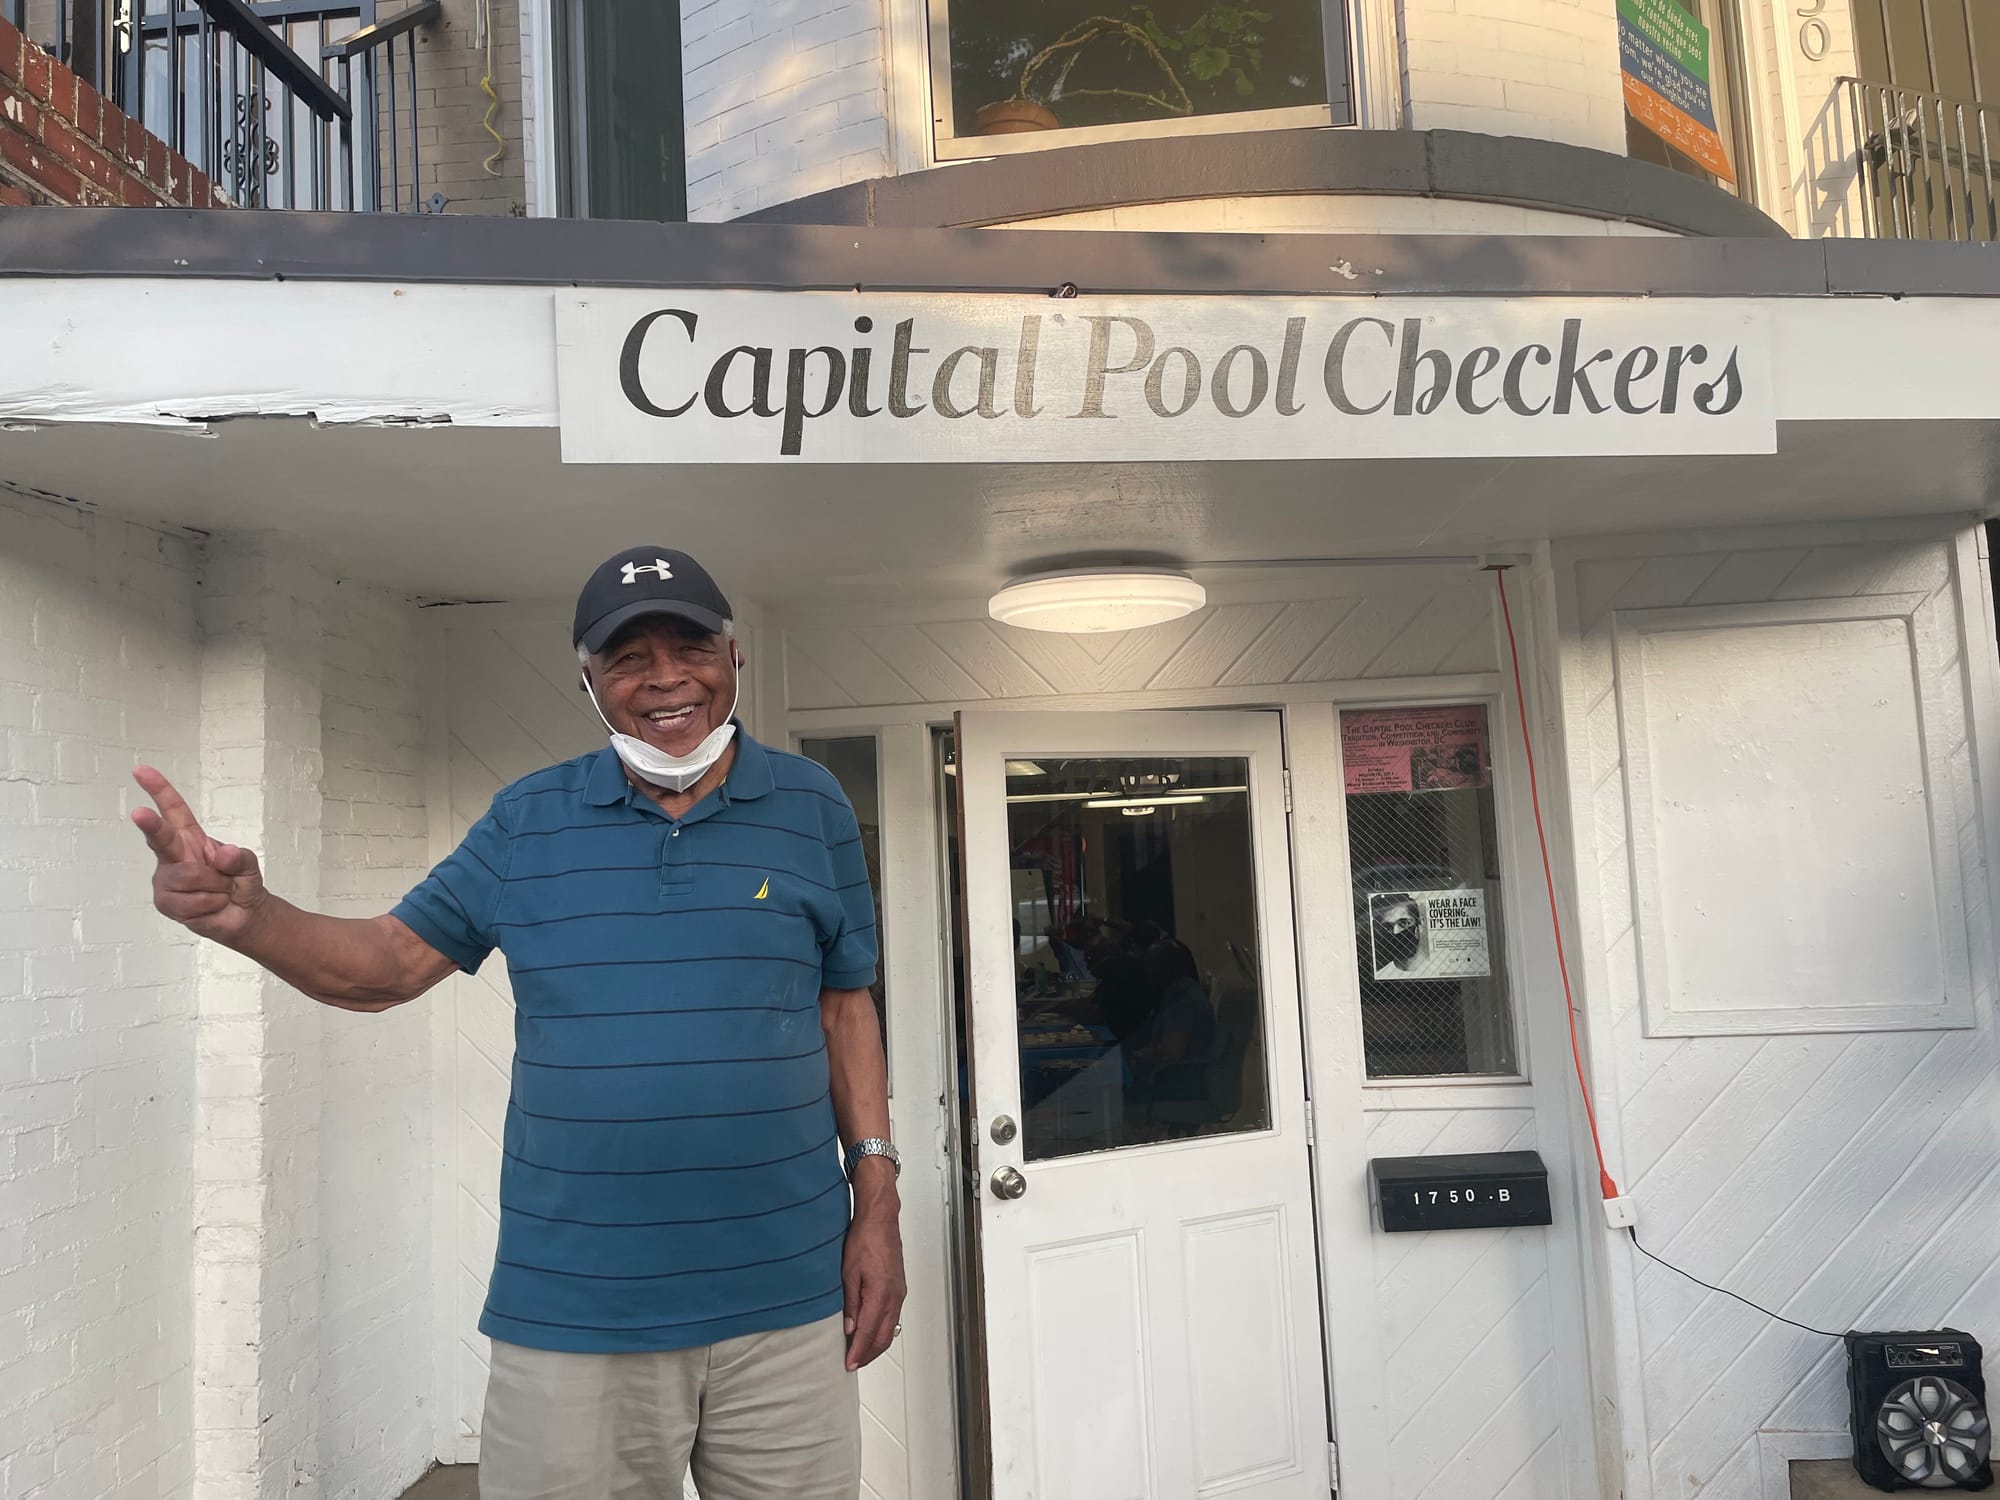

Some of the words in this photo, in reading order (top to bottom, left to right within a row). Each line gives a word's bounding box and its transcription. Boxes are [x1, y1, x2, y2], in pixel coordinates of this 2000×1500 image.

[1638, 15, 1660, 42] nuestro
[1647, 7, 1674, 38] contentos
[1628, 31, 1653, 58] matter
[1656, 53, 1678, 78] where
[1680, 72, 1694, 89] you
[1695, 84, 1707, 99] are
[1641, 56, 1663, 79] we're
[1665, 73, 1681, 93] glad
[1641, 70, 1654, 86] our
[618, 308, 1045, 456] Capital
[1066, 315, 1306, 418] Pool
[1323, 316, 1743, 416] Checkers
[1346, 725, 1360, 734] THE
[1362, 724, 1392, 734] CAPITAL
[1394, 722, 1413, 732] POOL
[1428, 898, 1451, 908] WEAR
[1452, 898, 1458, 908] A
[1460, 897, 1477, 907] FACE
[1429, 907, 1469, 918] COVERING.
[1430, 918, 1444, 929] IT'S
[1445, 918, 1460, 928] THE
[1461, 917, 1481, 927] LAW!
